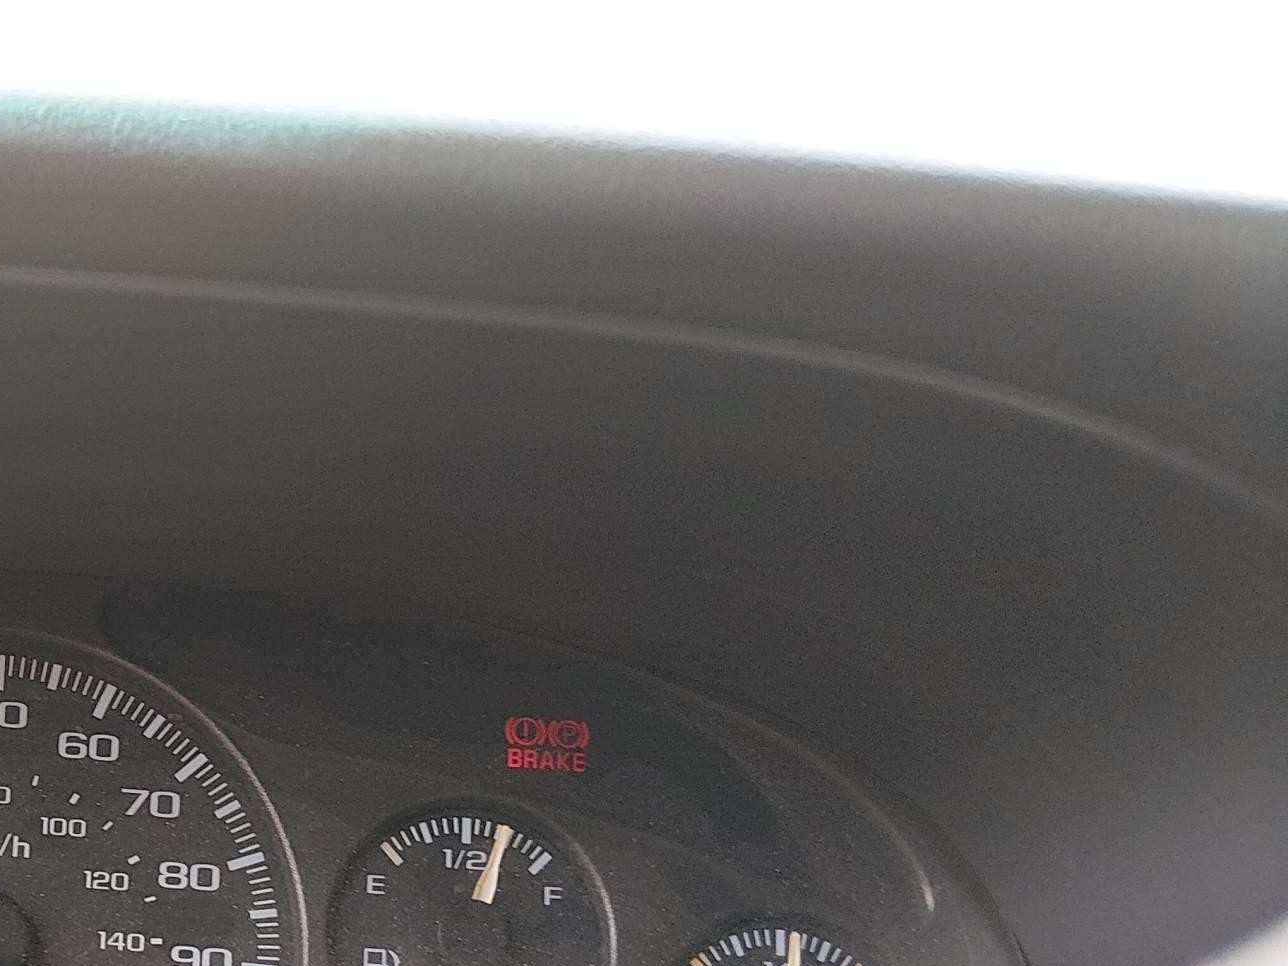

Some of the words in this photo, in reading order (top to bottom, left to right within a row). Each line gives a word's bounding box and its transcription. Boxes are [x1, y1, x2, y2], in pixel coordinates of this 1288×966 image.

[58, 733, 120, 761] 60
[507, 748, 585, 772] BRAKE
[121, 789, 180, 818] 70
[40, 816, 86, 837] 100
[442, 848, 488, 870] 1/2
[84, 871, 129, 891] 120
[157, 862, 220, 890] 80
[366, 875, 385, 894] E
[544, 885, 563, 905] F
[98, 932, 145, 952] 140
